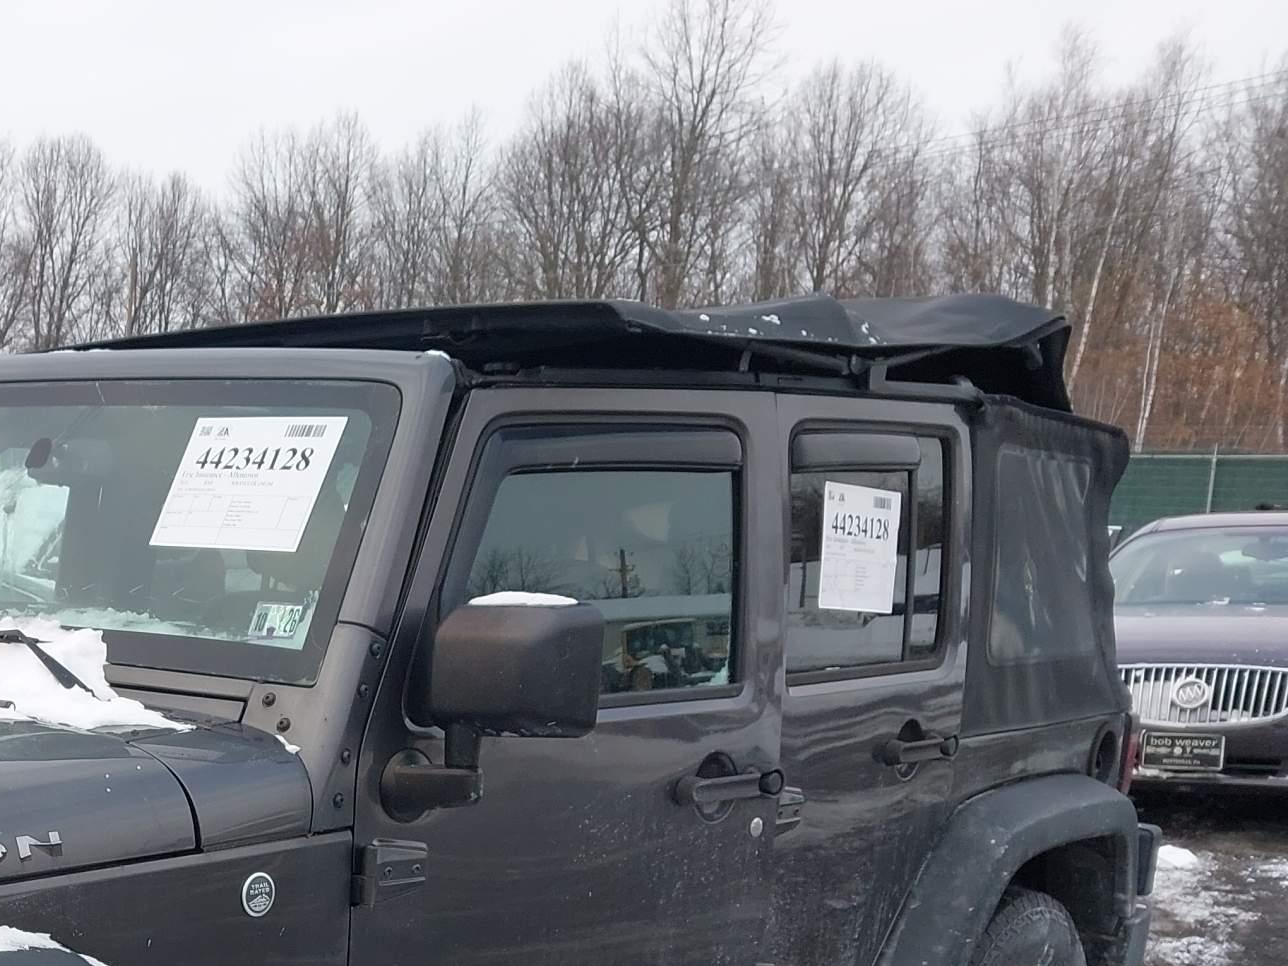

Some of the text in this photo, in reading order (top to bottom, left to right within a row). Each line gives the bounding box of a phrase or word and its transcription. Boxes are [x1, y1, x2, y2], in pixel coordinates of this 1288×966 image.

[195, 447, 314, 471] 44234128
[831, 511, 890, 541] 44234128
[282, 608, 301, 633] 26
[1150, 736, 1218, 747] bob weaver
